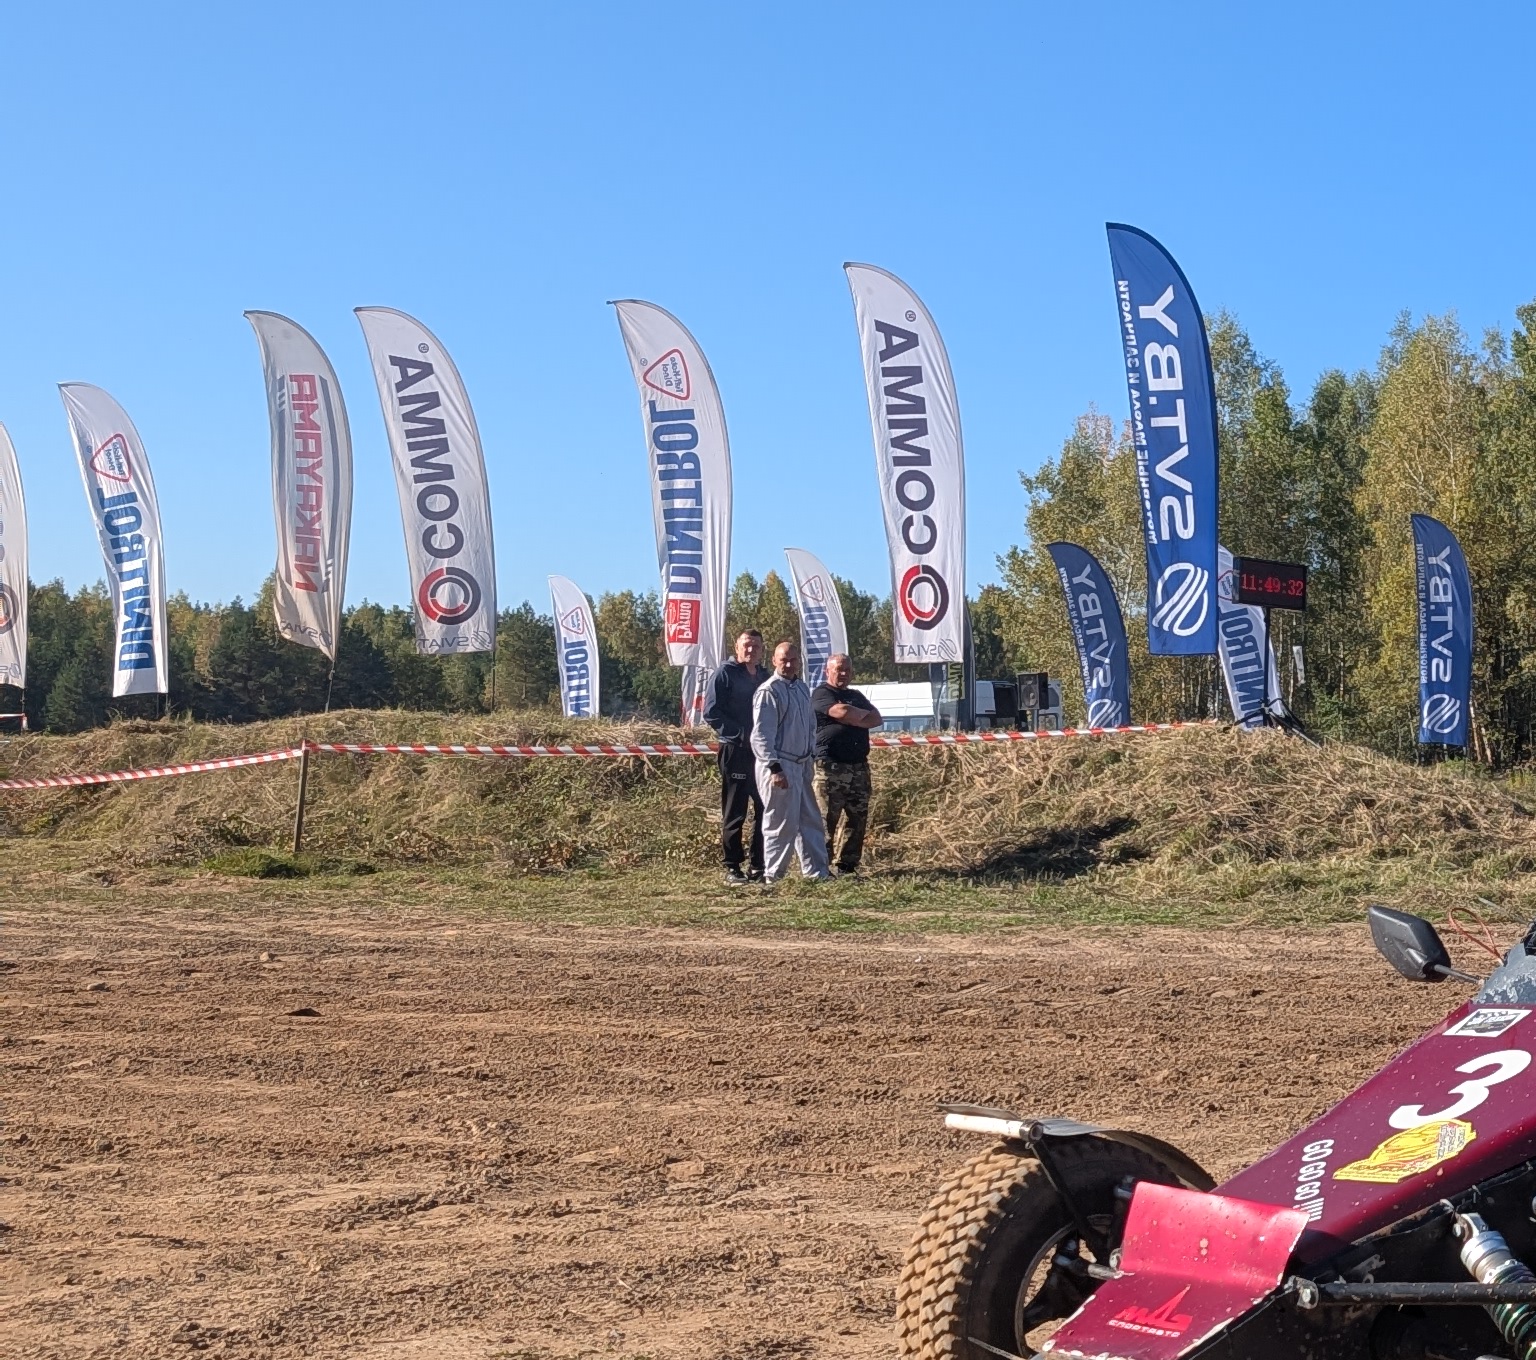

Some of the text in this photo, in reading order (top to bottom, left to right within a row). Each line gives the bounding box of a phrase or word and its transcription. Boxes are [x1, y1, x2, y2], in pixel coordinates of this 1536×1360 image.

[1388, 1049, 1532, 1129] 3
[1302, 1139, 1335, 1162] GO
[1297, 1161, 1327, 1182] GO
